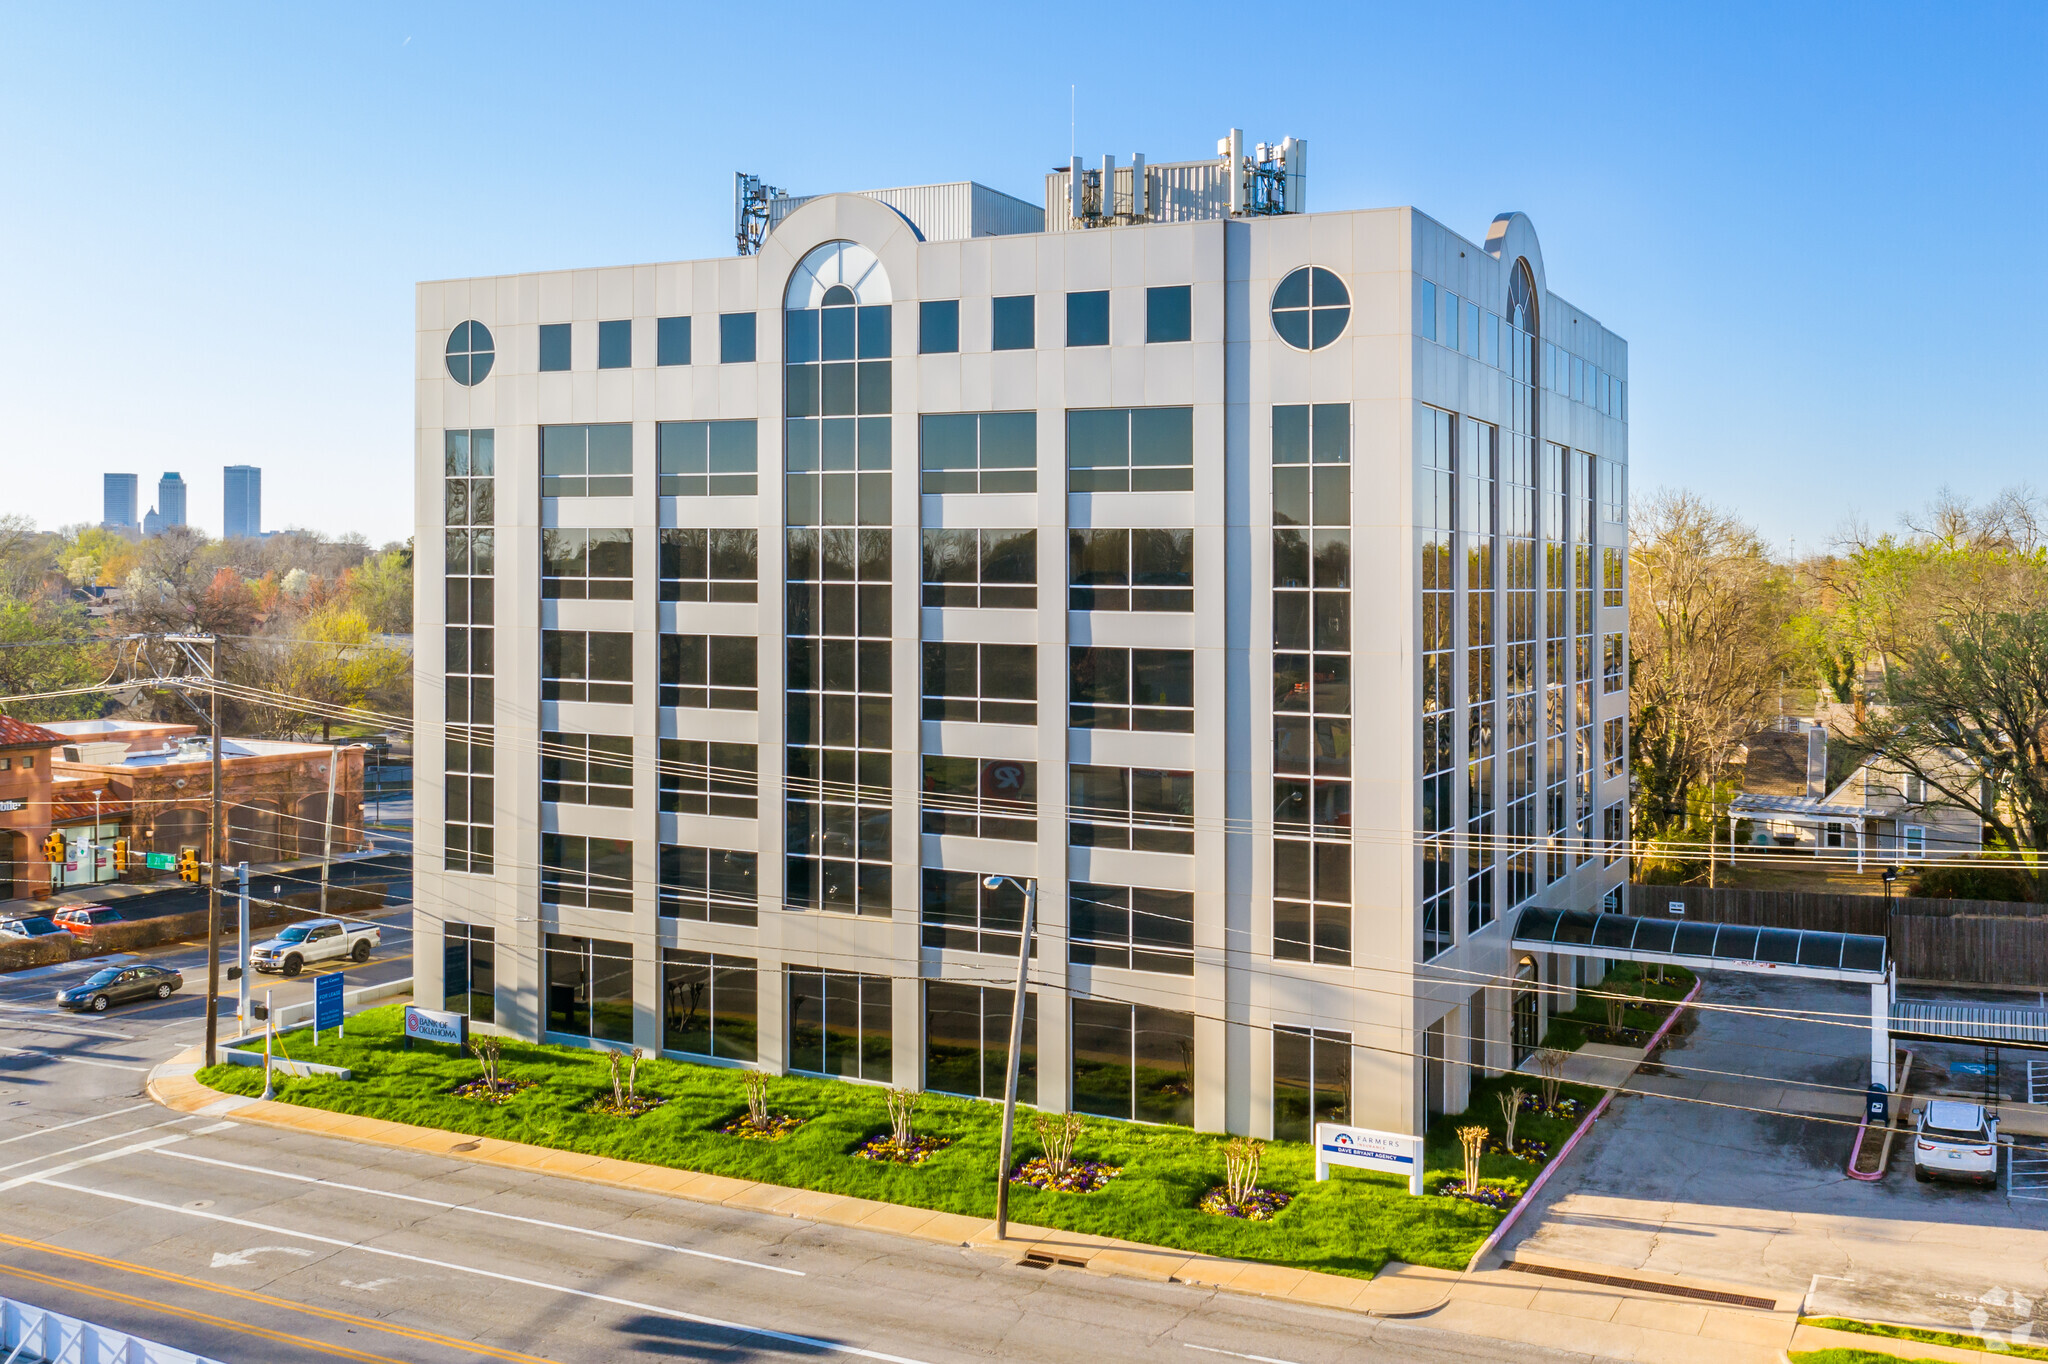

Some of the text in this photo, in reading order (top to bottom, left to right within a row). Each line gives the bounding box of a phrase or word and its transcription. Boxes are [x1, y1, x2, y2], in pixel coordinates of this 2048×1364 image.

[328, 990, 341, 998] LEASE
[419, 1017, 448, 1029] BANK OF
[418, 1025, 457, 1038] OKLAHOMA
[1357, 1136, 1400, 1148] FARMERS
[1353, 1149, 1374, 1157] BRYANT
